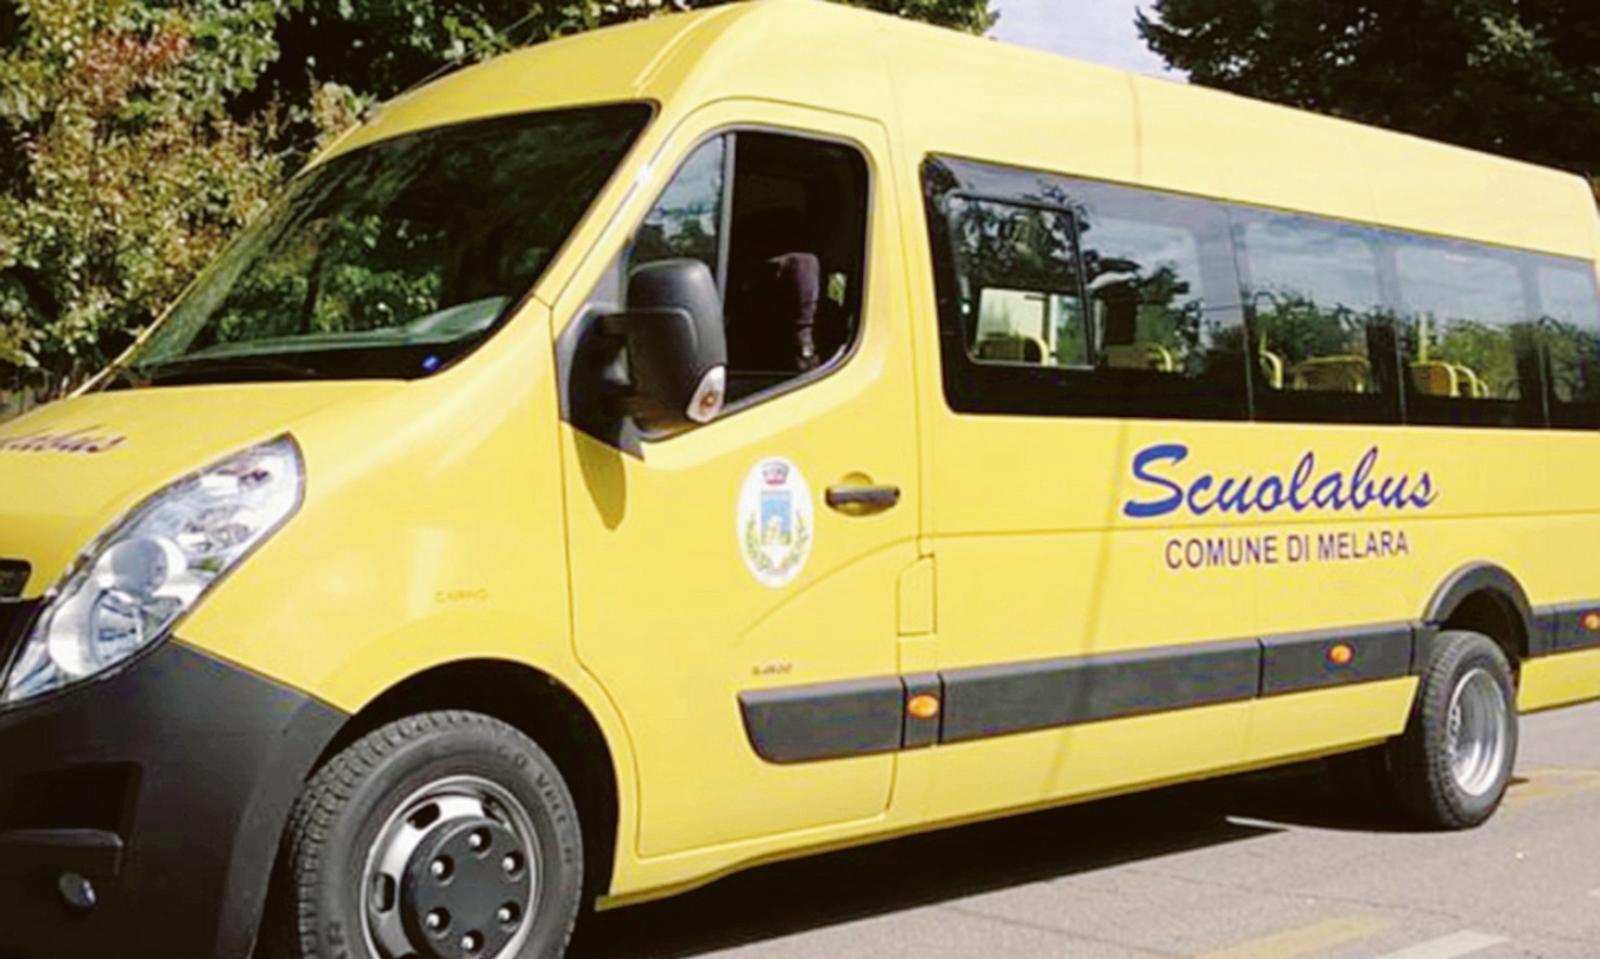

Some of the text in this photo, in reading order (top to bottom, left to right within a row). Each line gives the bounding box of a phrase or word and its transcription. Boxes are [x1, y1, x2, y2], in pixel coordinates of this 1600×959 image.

[1122, 444, 1438, 518] Scuolabus
[1165, 530, 1408, 569] COMUNE DI MELARA
